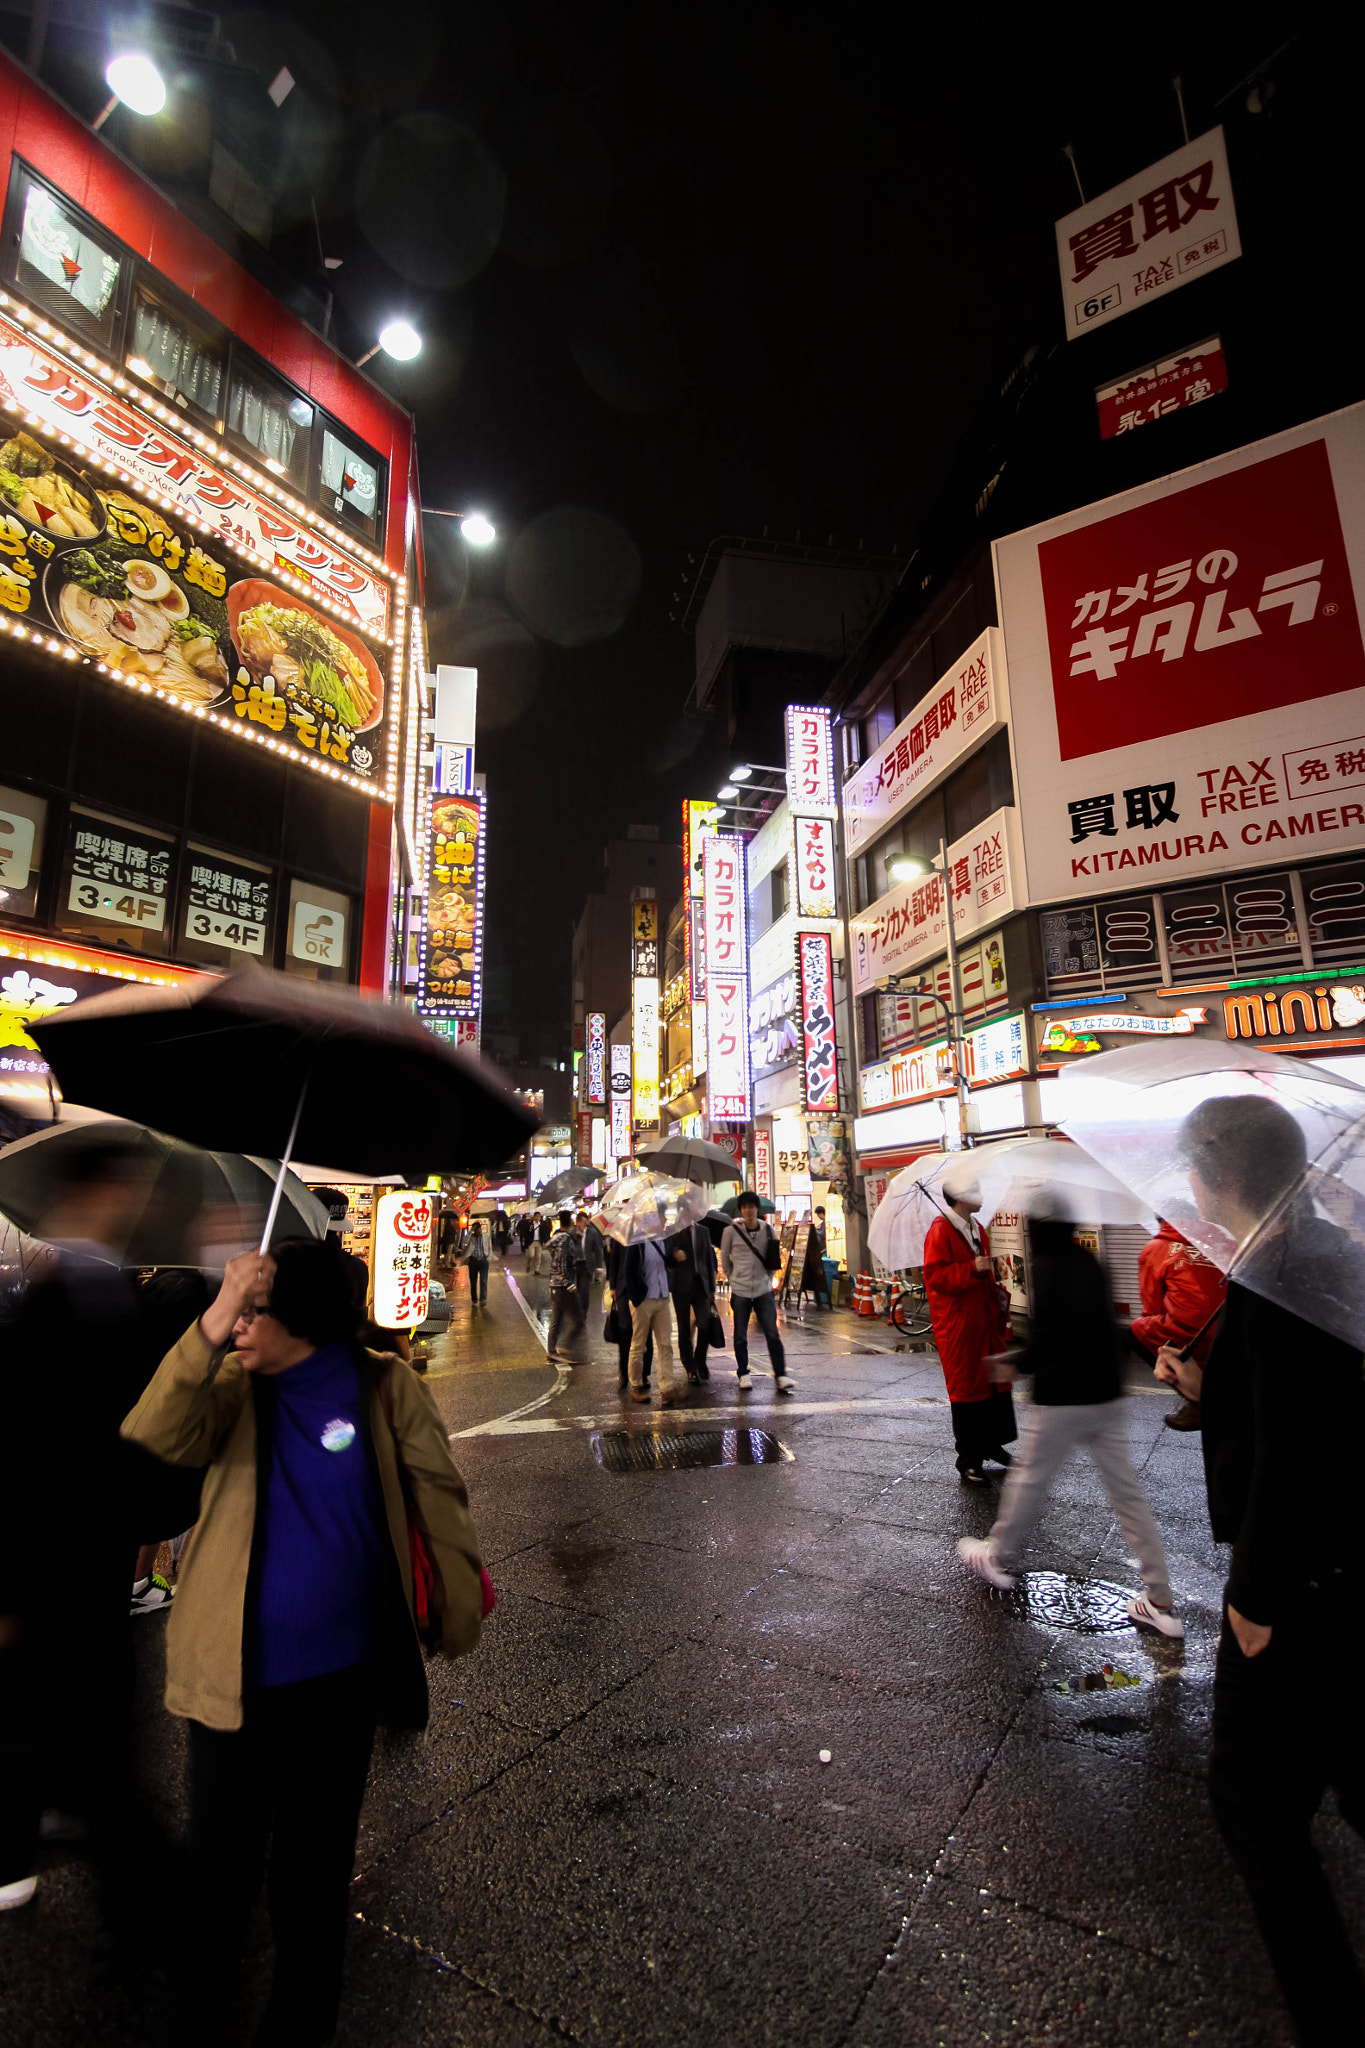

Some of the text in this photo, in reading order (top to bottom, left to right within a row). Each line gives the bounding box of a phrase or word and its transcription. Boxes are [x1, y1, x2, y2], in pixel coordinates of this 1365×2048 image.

[1069, 160, 1220, 284] 買取
[1184, 238, 1219, 265] 免税
[1133, 257, 1173, 283] TAX
[1134, 269, 1175, 296] FREE
[1083, 295, 1112, 317] 6F
[1115, 378, 1215, 436] 永仁堂
[95, 436, 145, 475] Karaoke
[147, 470, 175, 494] Mac
[219, 514, 257, 549] 24h
[108, 504, 228, 598] つけ麺
[1071, 549, 1238, 629] カメラの
[1069, 559, 1324, 681] キタムラ
[960, 652, 986, 684] TAX
[960, 670, 987, 708] FREE
[233, 665, 357, 763] 油そば
[801, 717, 822, 796] カラオケ
[1297, 749, 1365, 785] 免税
[888, 755, 934, 804] USED CAMERA
[1197, 757, 1275, 795] TAX
[1068, 781, 1180, 844] 買取
[1200, 783, 1279, 818] FREE
[75, 831, 149, 869] 喫煙席
[973, 831, 1002, 863] TAX
[1071, 831, 1229, 878] KITAMURA
[73, 855, 167, 894] ございます
[151, 864, 167, 877] OK
[191, 865, 252, 898] 喫煙席
[975, 851, 1003, 883] FREE
[189, 887, 267, 922] ございます
[252, 894, 267, 905] OK
[882, 946, 903, 964] DIGITAL
[903, 931, 928, 952] CAMERA
[941, 908, 966, 931] POTO
[1045, 912, 1094, 930] アパート
[1046, 927, 1095, 943] マンション
[305, 941, 330, 959] OK
[714, 859, 737, 1056] カラオケ マック
[427, 979, 472, 996] つけ麺
[1224, 986, 1333, 1039] mini
[892, 1055, 925, 1097] mini
[640, 1119, 653, 1127] 2F
[714, 1096, 745, 1116] 24h
[755, 1132, 768, 1140] 2F
[779, 1161, 805, 1172] マック
[395, 1273, 411, 1321] ラーメン
[413, 1272, 428, 1317] 豚骨
